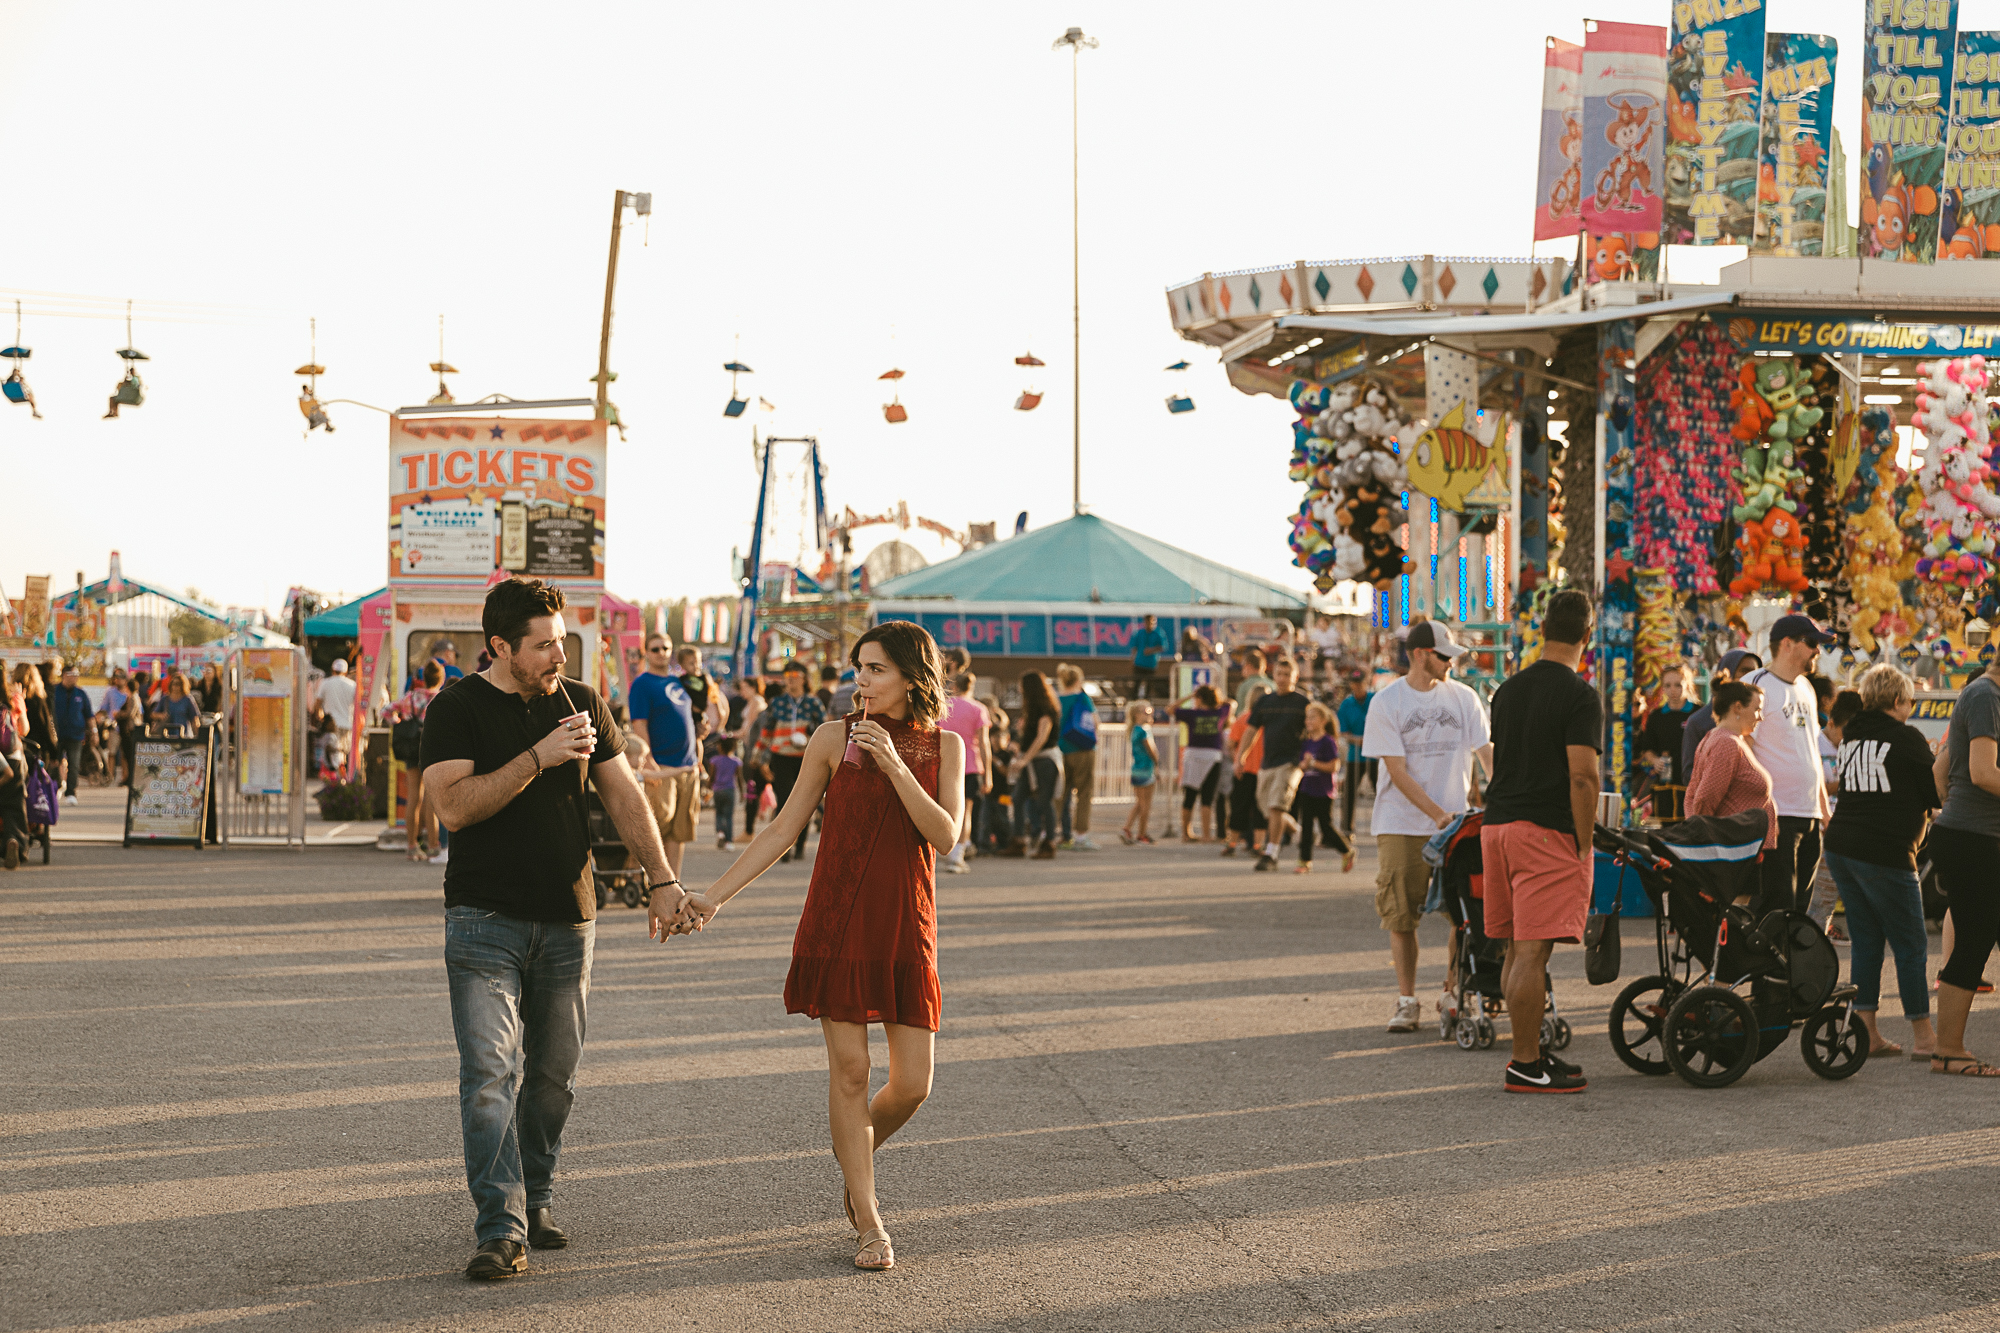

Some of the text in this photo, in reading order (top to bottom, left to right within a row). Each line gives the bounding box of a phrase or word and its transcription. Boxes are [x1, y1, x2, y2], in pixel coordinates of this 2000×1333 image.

[1873, 0, 1949, 30] FISH
[1874, 33, 1943, 67] TILL
[1957, 53, 2000, 83] ISH
[1872, 72, 1940, 108] YOU
[1868, 111, 1940, 148] WIN!
[1760, 321, 1929, 349] LET'S GO FISHING
[1963, 325, 2000, 349] LET
[398, 447, 597, 495] TICKETS
[942, 618, 1146, 646] SOFT SERV
[137, 755, 161, 766] TOO
